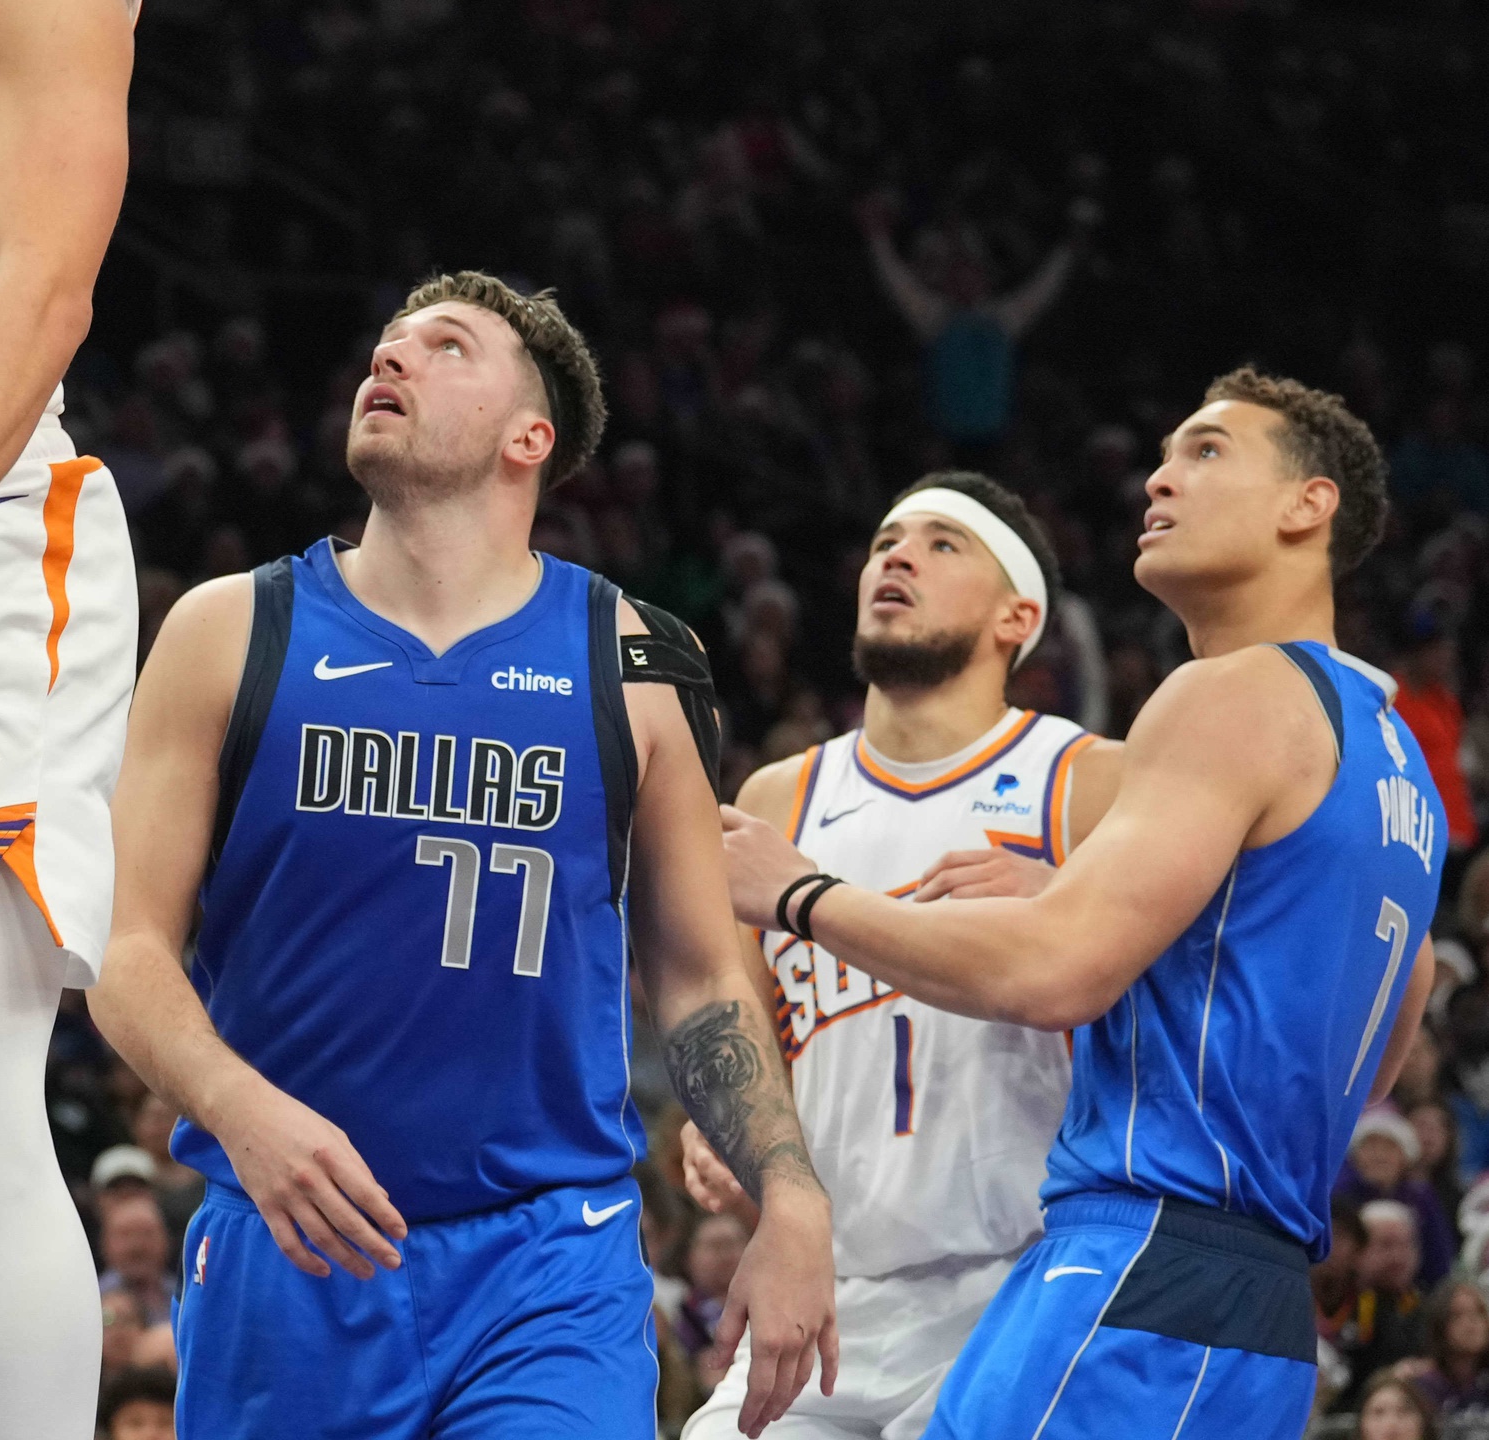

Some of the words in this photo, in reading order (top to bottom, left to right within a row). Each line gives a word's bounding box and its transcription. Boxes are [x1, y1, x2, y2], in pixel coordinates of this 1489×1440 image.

[490, 666, 573, 696] chime
[629, 647, 649, 667] KT
[295, 723, 566, 832] DALLAS
[971, 800, 1032, 816] PayPal
[1375, 774, 1435, 876] POWELL
[415, 834, 555, 978] 77
[1344, 895, 1410, 1097] 7
[893, 1014, 914, 1138] 1
